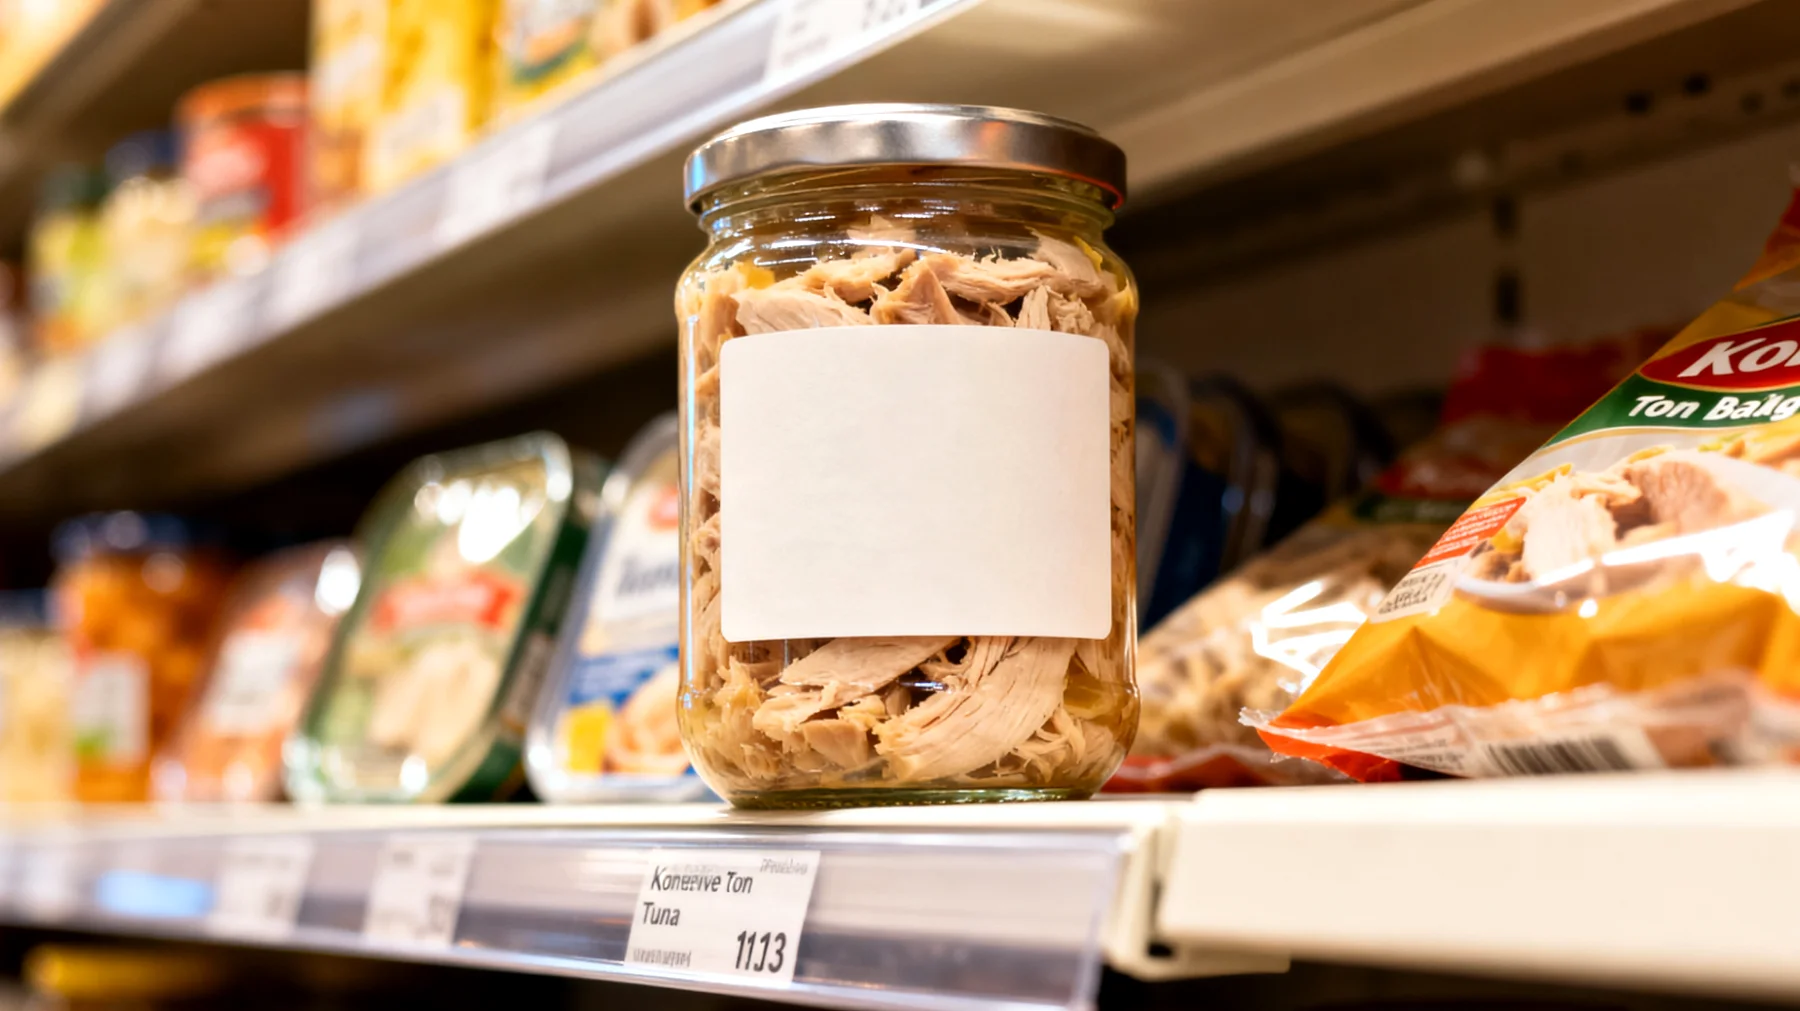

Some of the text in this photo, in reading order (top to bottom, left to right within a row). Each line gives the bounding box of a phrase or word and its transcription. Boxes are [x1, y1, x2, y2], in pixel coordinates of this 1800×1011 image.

[1628, 395, 1700, 419] Ton
[726, 871, 753, 894] Ton
[643, 901, 681, 926] Tuna
